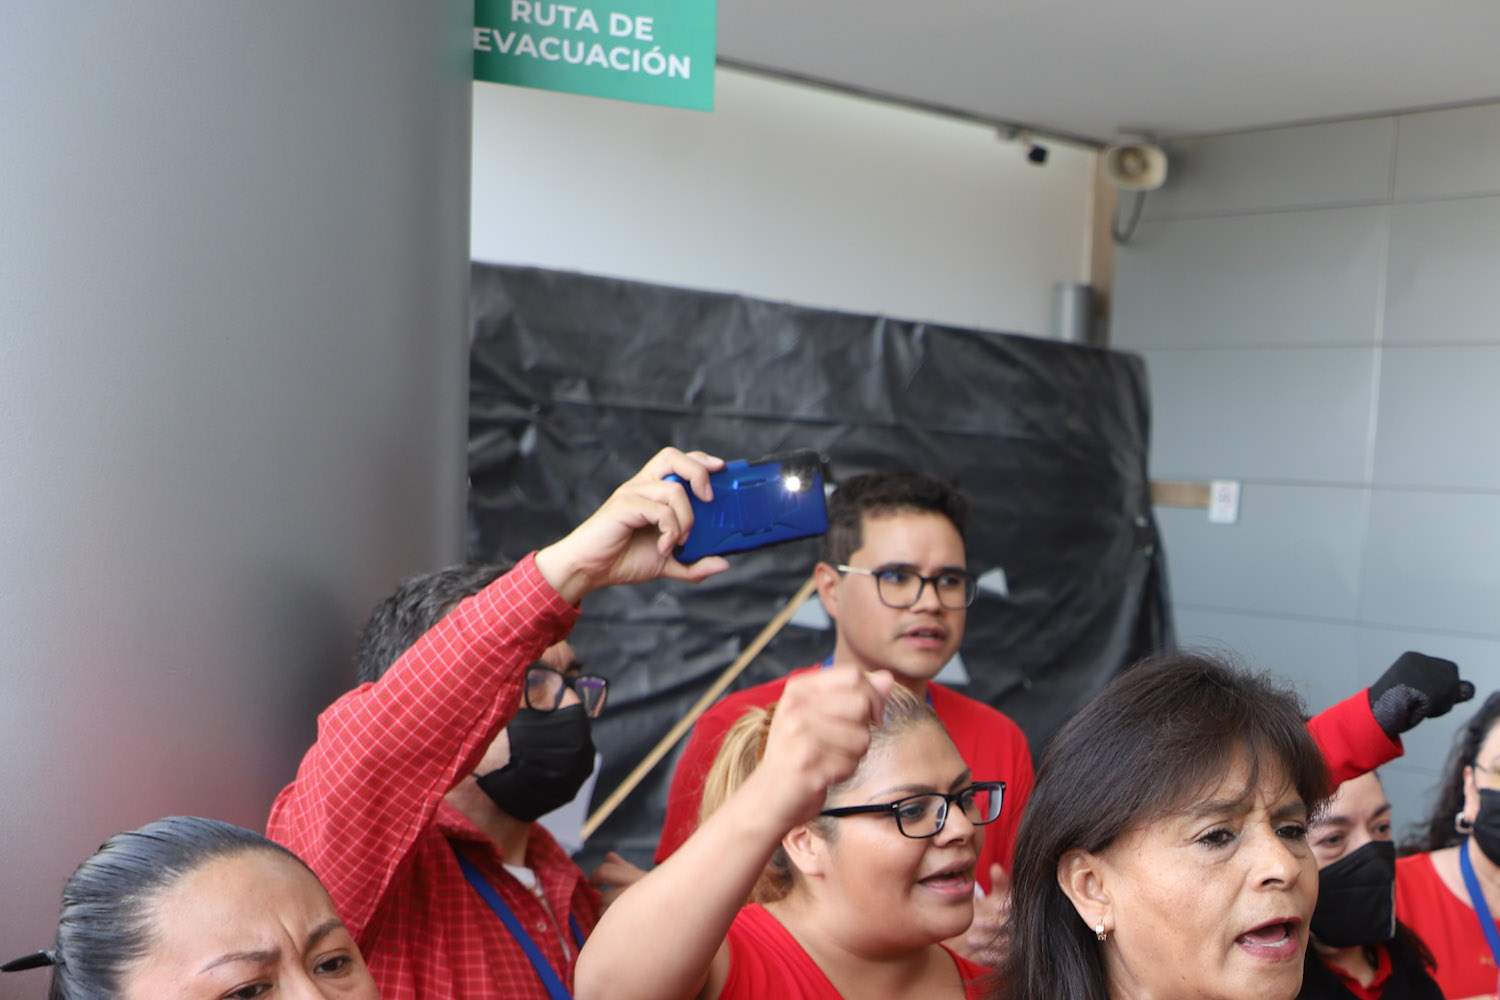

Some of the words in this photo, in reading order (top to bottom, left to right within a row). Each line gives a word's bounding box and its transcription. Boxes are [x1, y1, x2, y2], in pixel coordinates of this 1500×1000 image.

[510, 0, 600, 33] RUTA
[610, 13, 654, 41] DE
[473, 27, 691, 79] EVACUACIÓN
